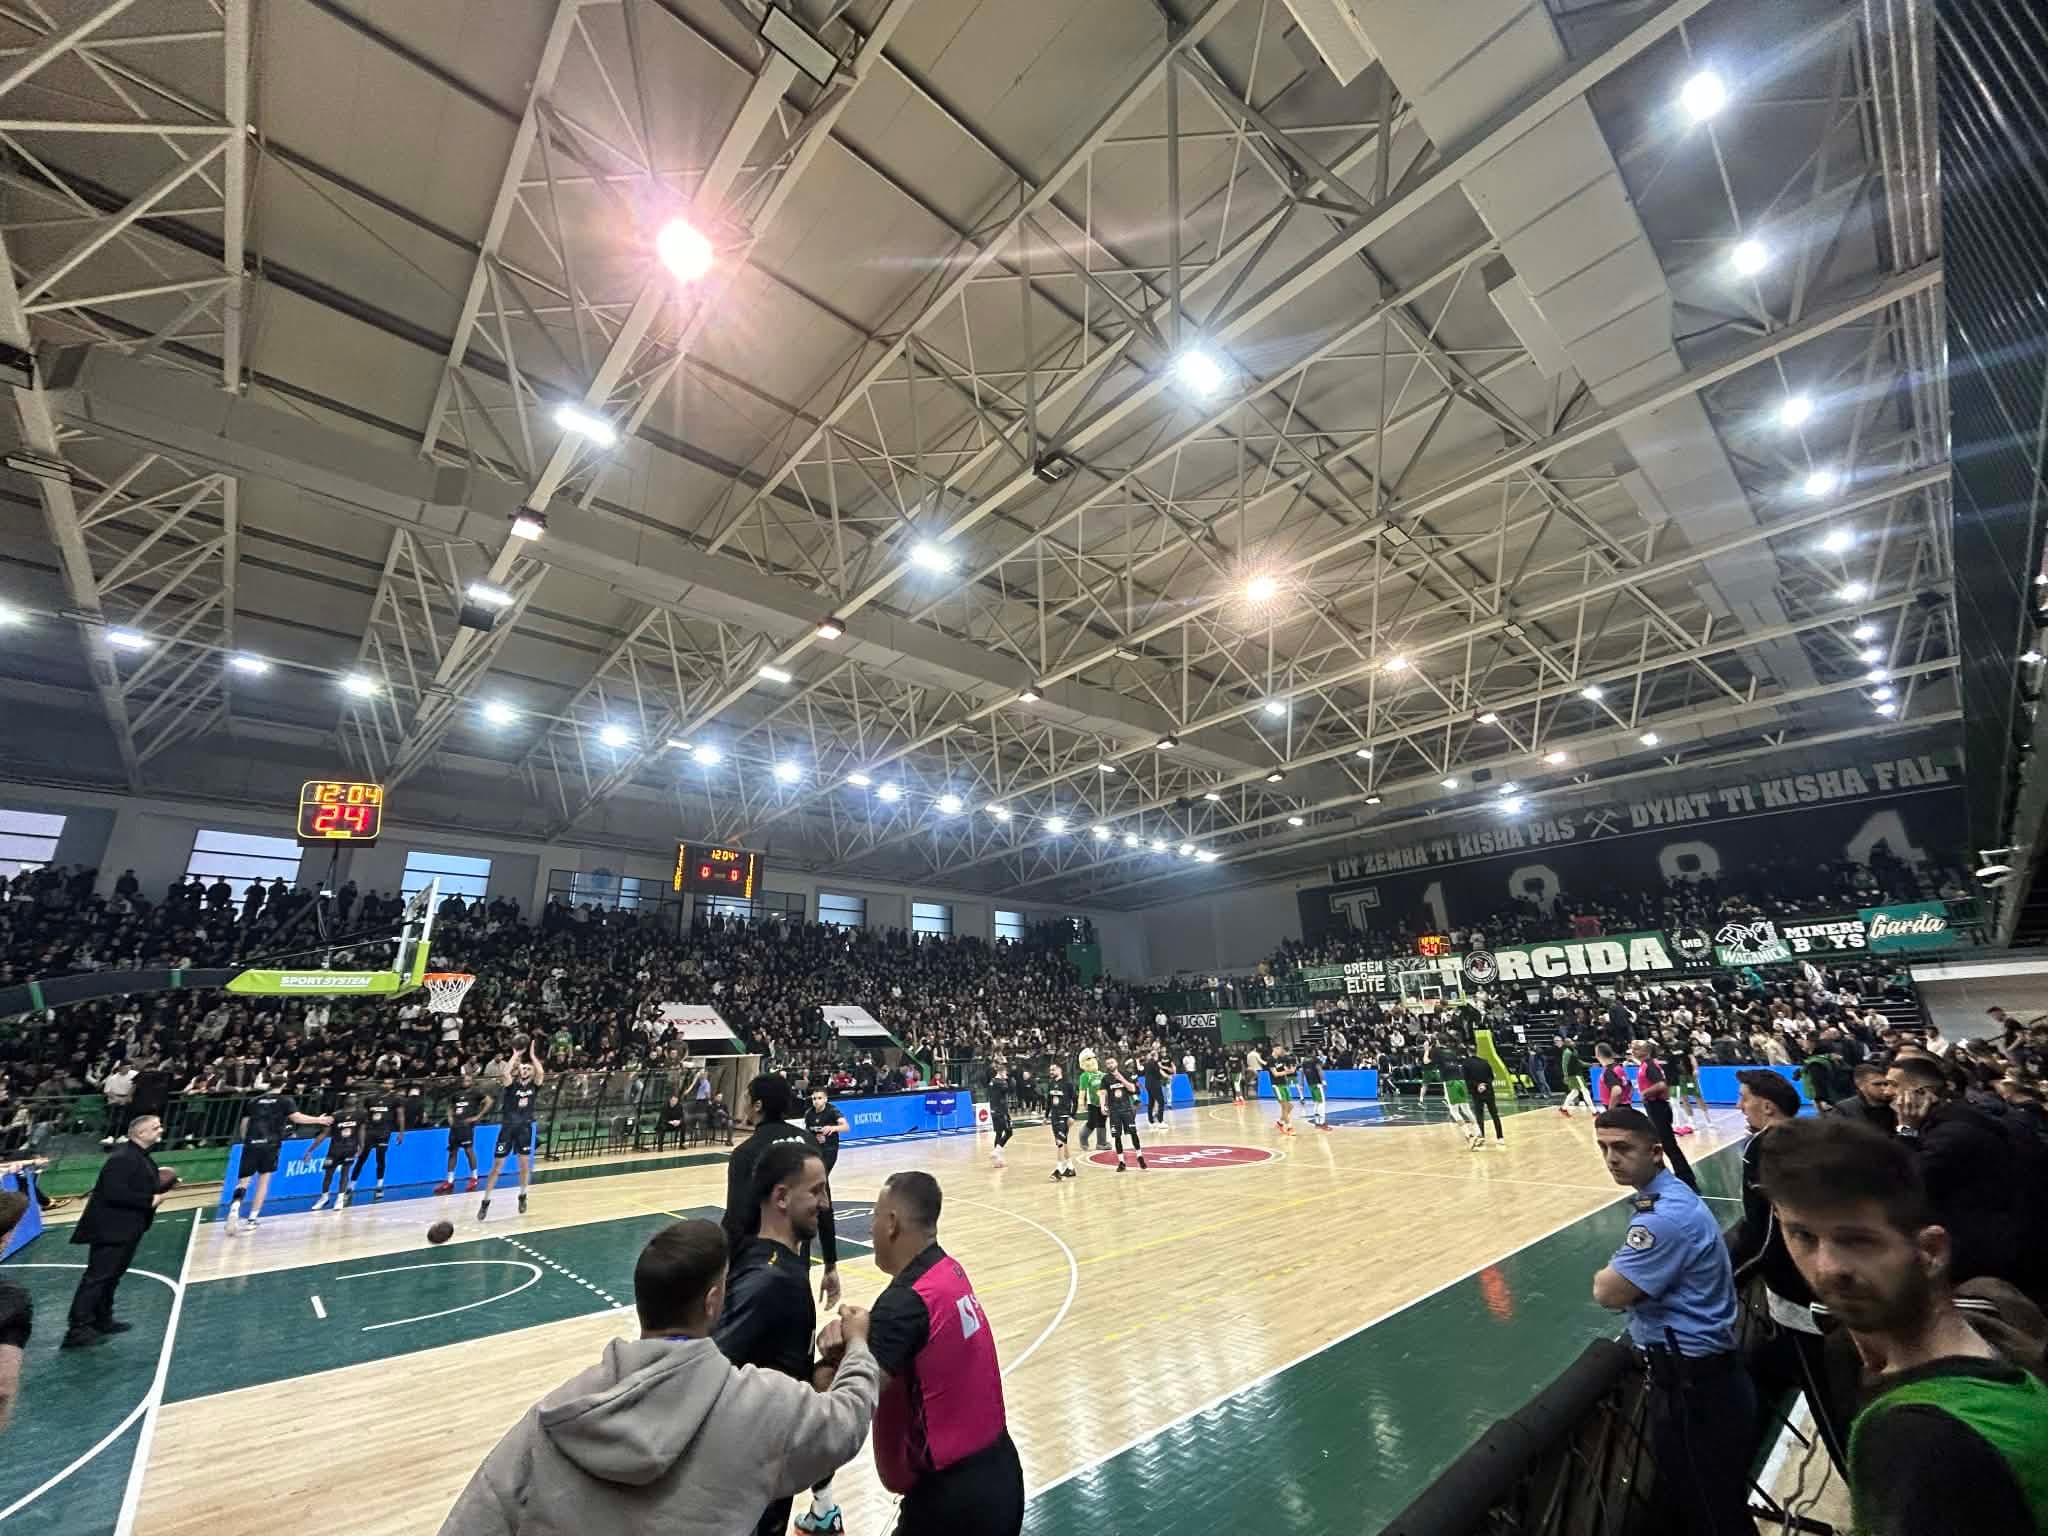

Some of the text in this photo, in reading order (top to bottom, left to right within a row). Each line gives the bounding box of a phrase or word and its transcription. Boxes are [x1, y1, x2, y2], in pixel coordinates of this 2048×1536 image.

[314, 784, 380, 803] 12:04
[314, 805, 366, 831] 24
[1338, 755, 1950, 878] DY ZEMRA TI KISHA PAS DYJAT TI KISHA FAL
[1783, 920, 1866, 939] MINERS
[1870, 912, 1947, 940] Garda
[1343, 960, 1384, 975] GREEN
